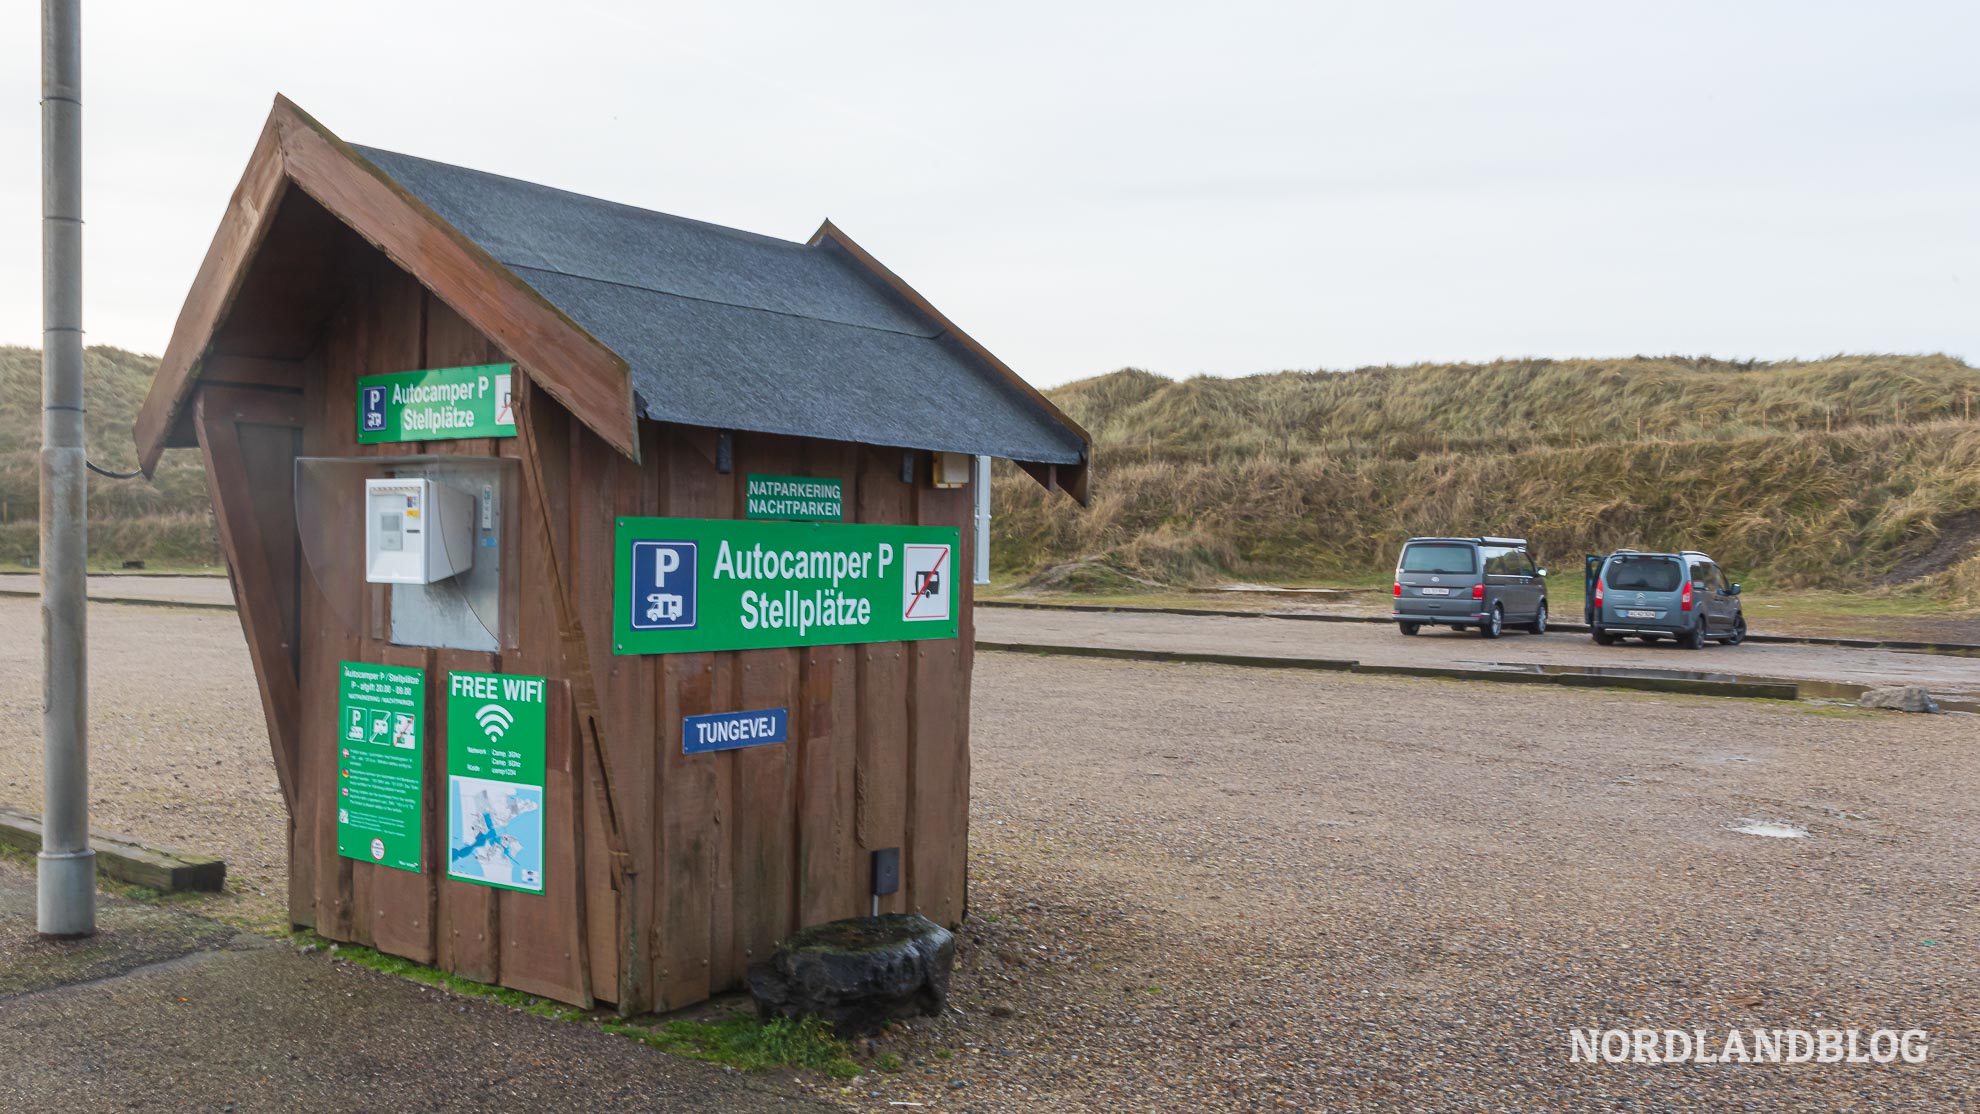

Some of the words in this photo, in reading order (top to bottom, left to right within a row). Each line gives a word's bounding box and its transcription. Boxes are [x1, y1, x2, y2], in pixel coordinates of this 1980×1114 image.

[370, 390, 380, 410] P
[392, 382, 475, 405] Autocamper
[478, 376, 489, 399] P
[403, 405, 474, 434] Stellplätze
[749, 480, 841, 499] NATPARKERING
[749, 499, 841, 516] NACHTPARKEN
[655, 548, 680, 588] P
[712, 540, 872, 588] Autocamper
[878, 543, 894, 579] P
[740, 589, 871, 637] Stellplätze
[452, 675, 498, 699] FREE
[502, 678, 543, 703] WIFI
[696, 716, 776, 744] TUNGEVEJ
